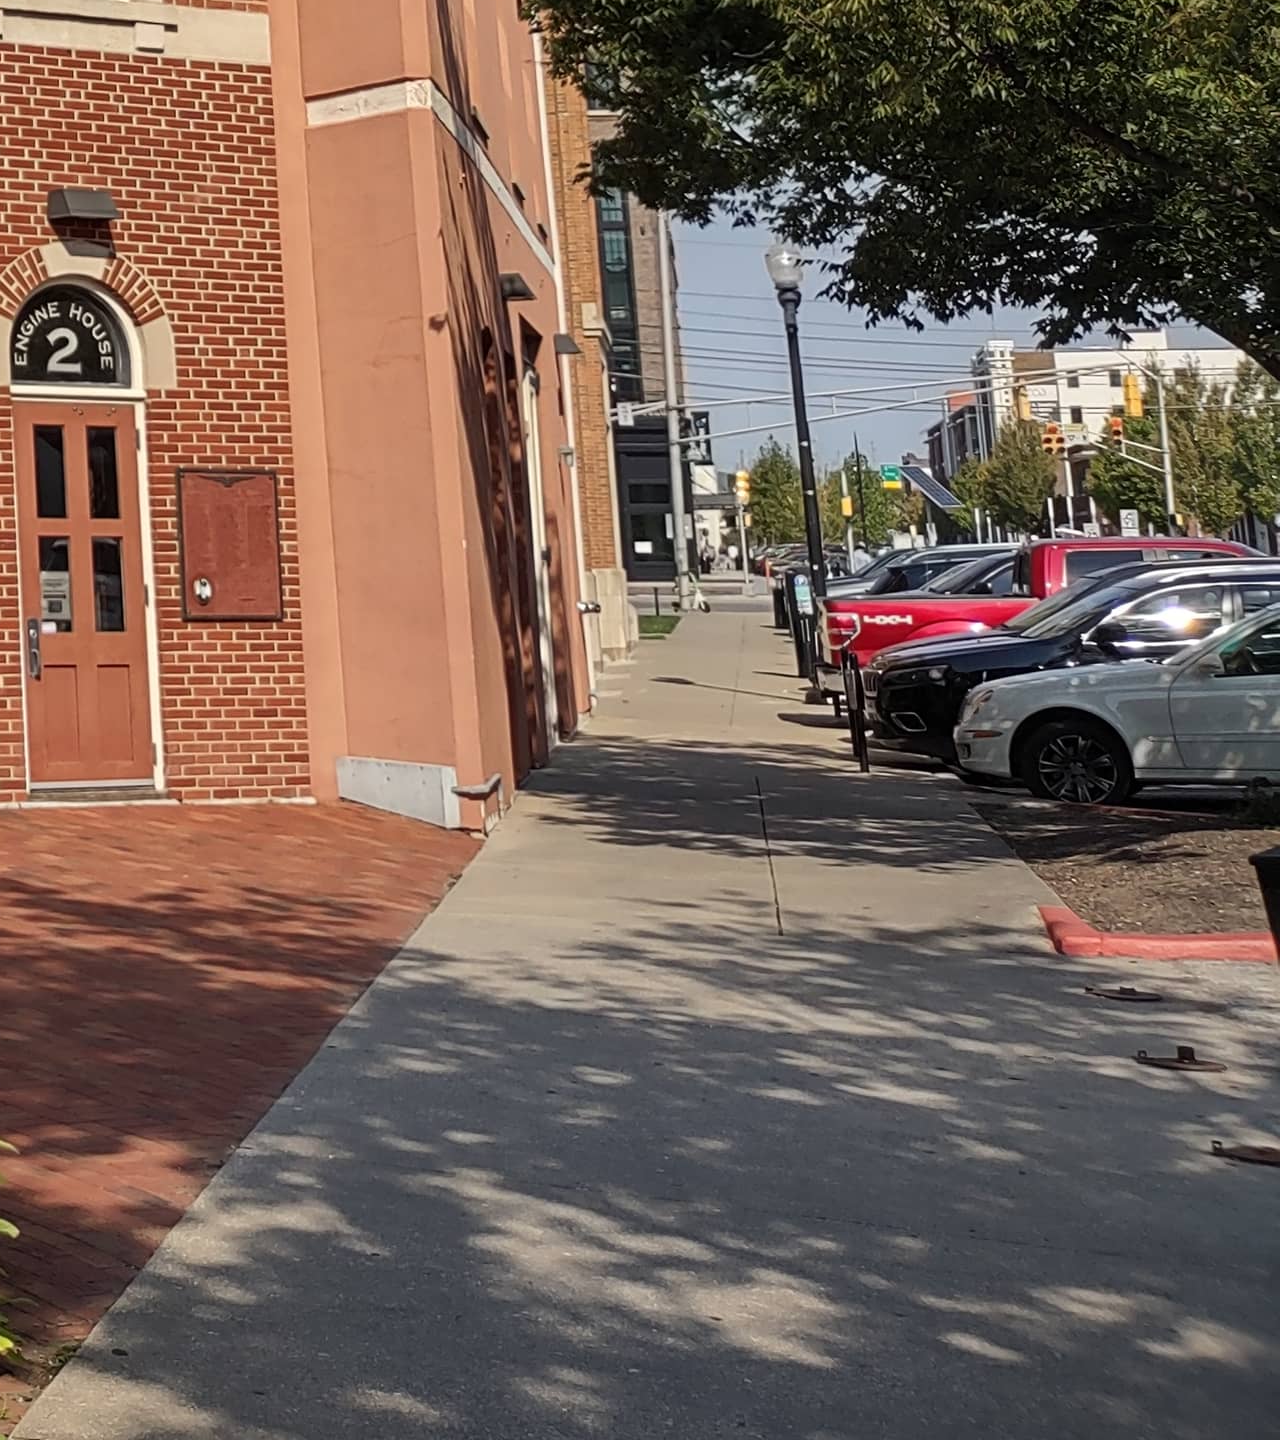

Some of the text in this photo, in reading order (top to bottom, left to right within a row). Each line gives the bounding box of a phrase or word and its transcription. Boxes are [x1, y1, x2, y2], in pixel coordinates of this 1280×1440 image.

[13, 301, 114, 370] ENGINE HOUSE
[45, 327, 83, 375] 2
